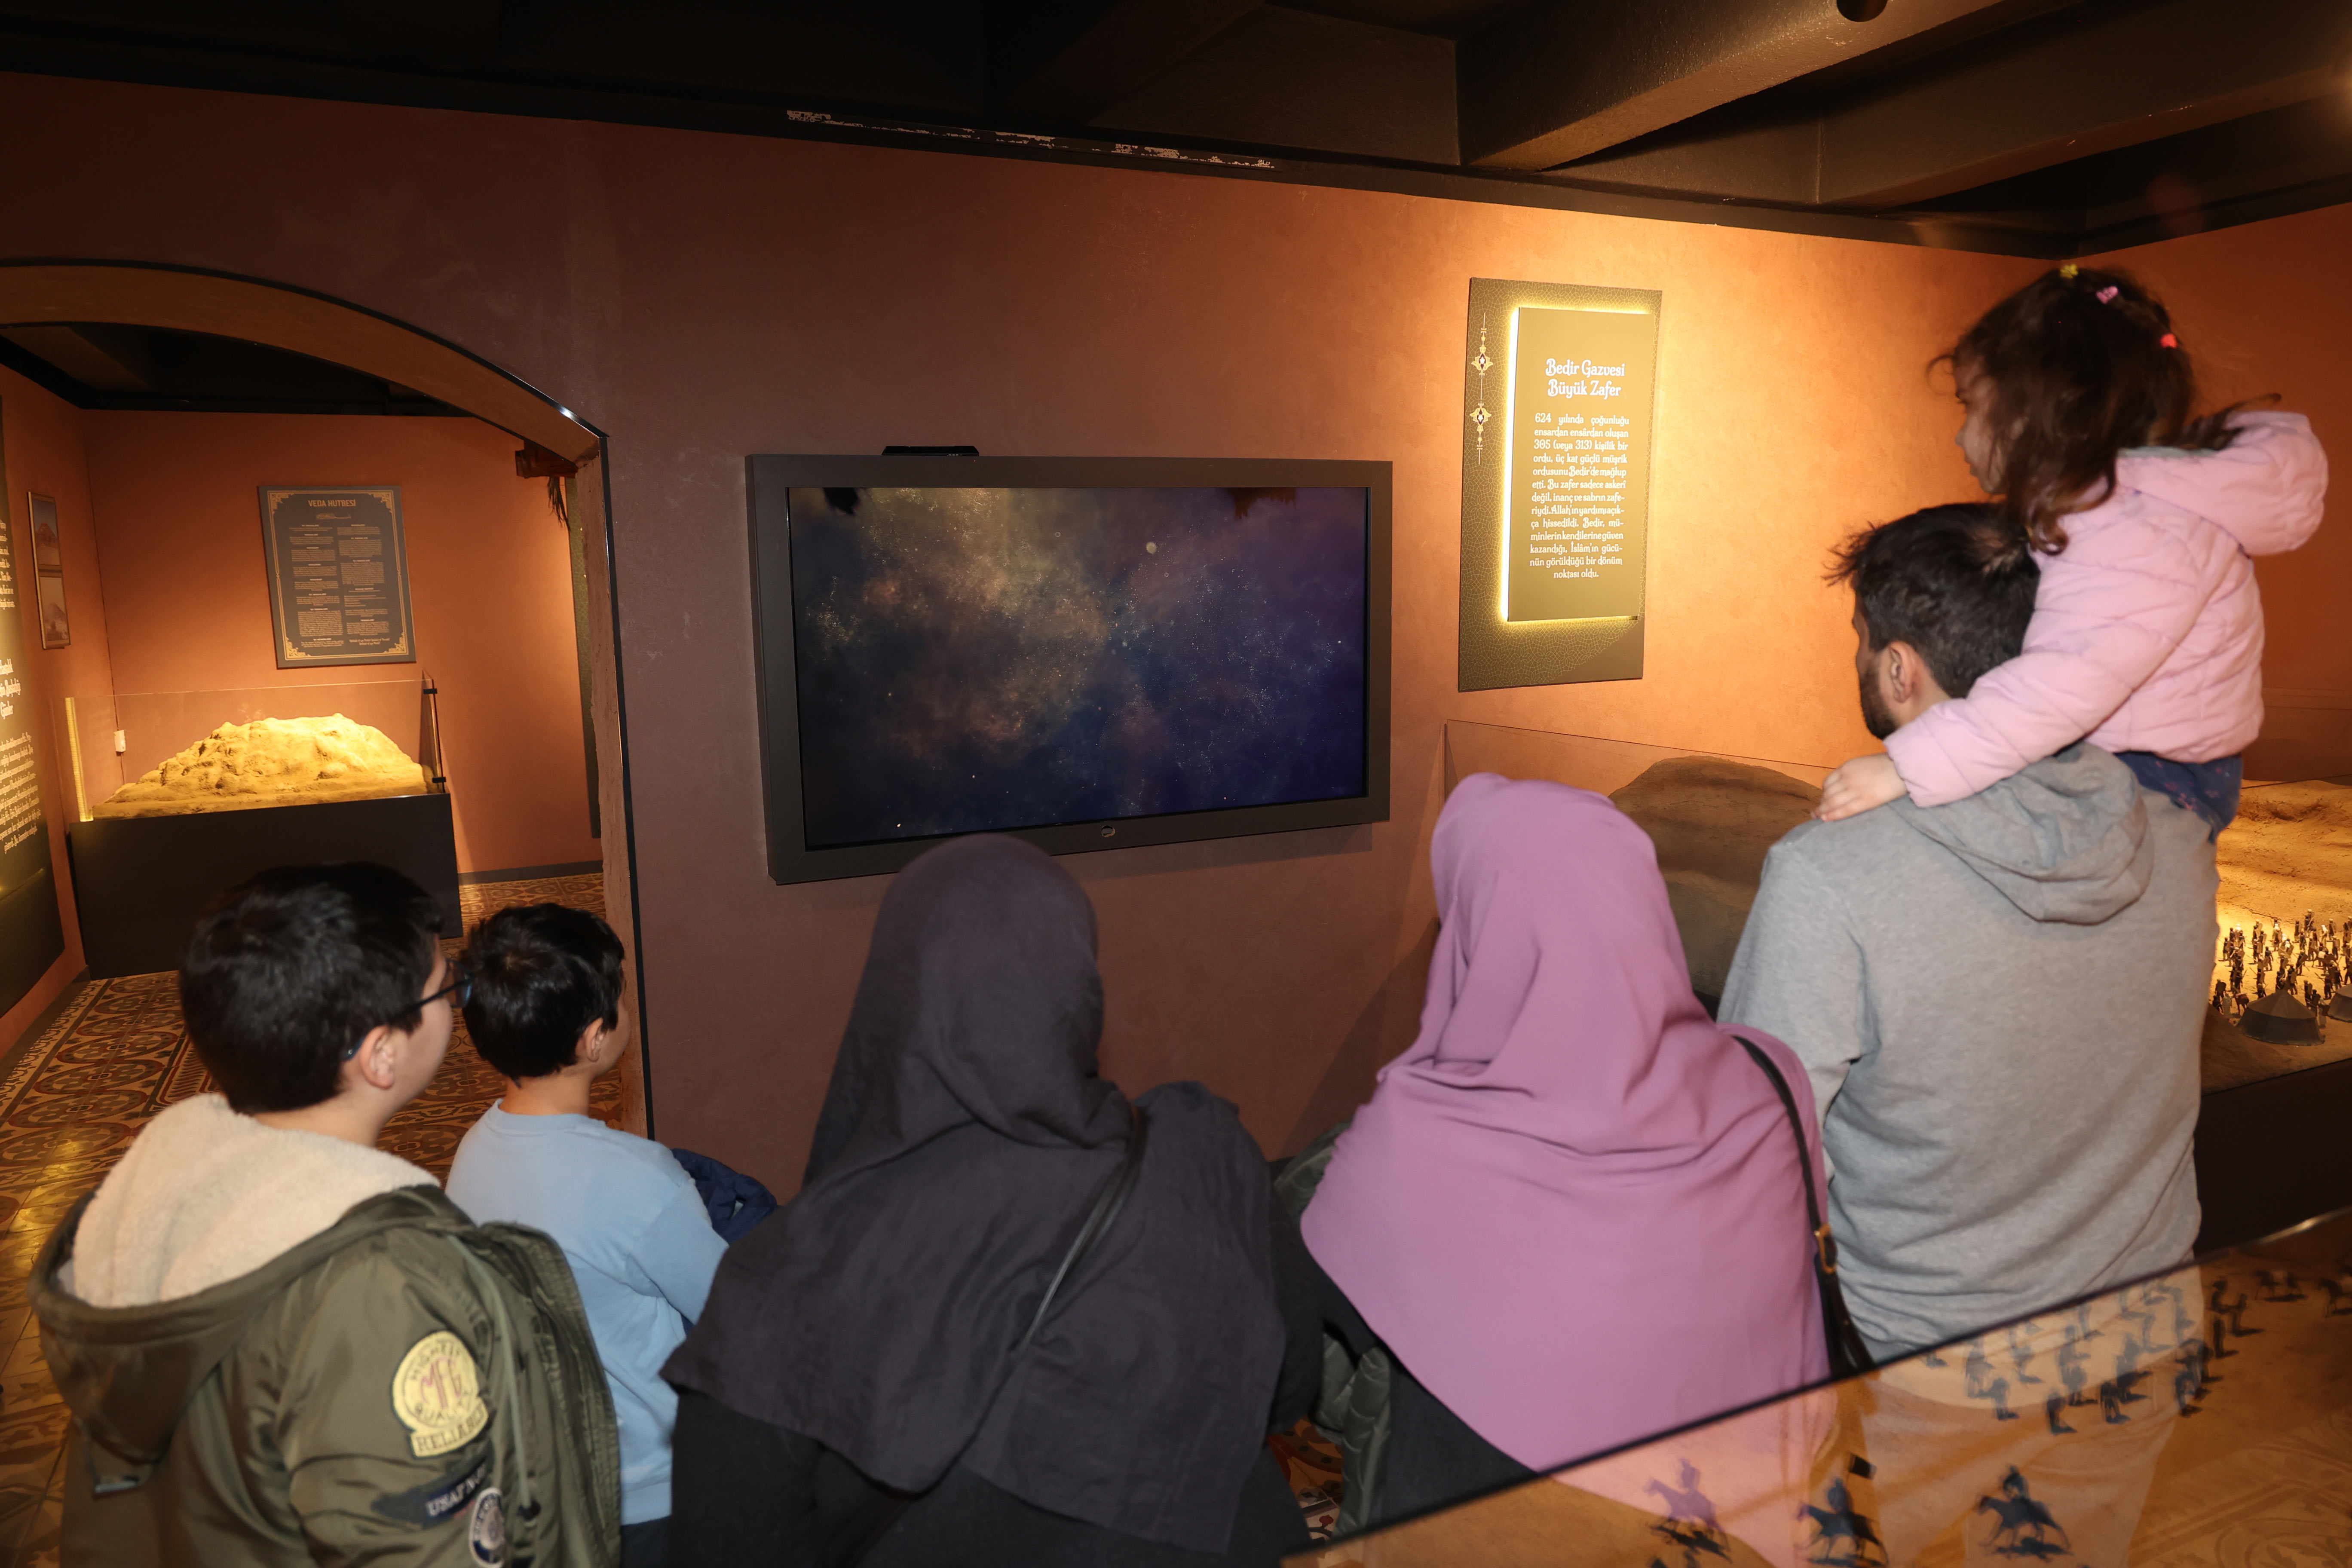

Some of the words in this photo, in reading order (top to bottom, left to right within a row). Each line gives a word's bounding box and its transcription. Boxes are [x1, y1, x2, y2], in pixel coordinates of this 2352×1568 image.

[1546, 358, 1579, 376] Bedir
[1581, 360, 1625, 377] Gazvesi
[1548, 379, 1587, 398] Büyük
[1590, 380, 1621, 400] Zafer
[1535, 413, 1551, 423] 624
[1559, 413, 1584, 425] yılında
[1591, 415, 1629, 427] çoğunluğu
[1534, 426, 1568, 437] ensardan
[1570, 427, 1603, 438] ensârdan
[1605, 428, 1629, 439] oluşan
[1534, 439, 1551, 449] 305
[1553, 440, 1573, 452] (veya
[1575, 440, 1592, 450] 313)
[1594, 440, 1615, 452] kişilik
[1617, 441, 1629, 450] bir
[1533, 453, 1553, 463] ordu,
[1556, 454, 1565, 464] üç
[1566, 453, 1578, 463] kat
[1580, 453, 1600, 465] güçlü
[1602, 454, 1627, 465] müşrik
[1533, 466, 1568, 475] ordusunu
[1600, 466, 1626, 478] mağlup
[1532, 480, 1546, 489] etti.
[1547, 478, 1559, 490] Bu
[1560, 479, 1579, 491] zafer
[1580, 479, 1603, 489] sadece
[1531, 492, 1552, 504] değil,
[1553, 493, 1573, 503] inanç
[1583, 491, 1605, 501] sabrın
[1607, 492, 1625, 503] zafe-
[1531, 521, 1539, 530] ça
[1543, 518, 1579, 528] hissedildi.
[1583, 517, 1605, 528] Bedir,
[1608, 519, 1624, 527] mü-
[1531, 531, 1562, 541] minlerin
[1562, 530, 1602, 540] kendilerine
[1602, 531, 1623, 542] güven
[1530, 544, 1567, 555] kazandığı,
[1602, 544, 1623, 554] gücü-
[1546, 556, 1584, 568] görüldüğü
[1586, 556, 1597, 565] bir
[1598, 555, 1623, 565] dönüm
[1553, 569, 1579, 579] noktası
[1581, 568, 1599, 578] oldu.
